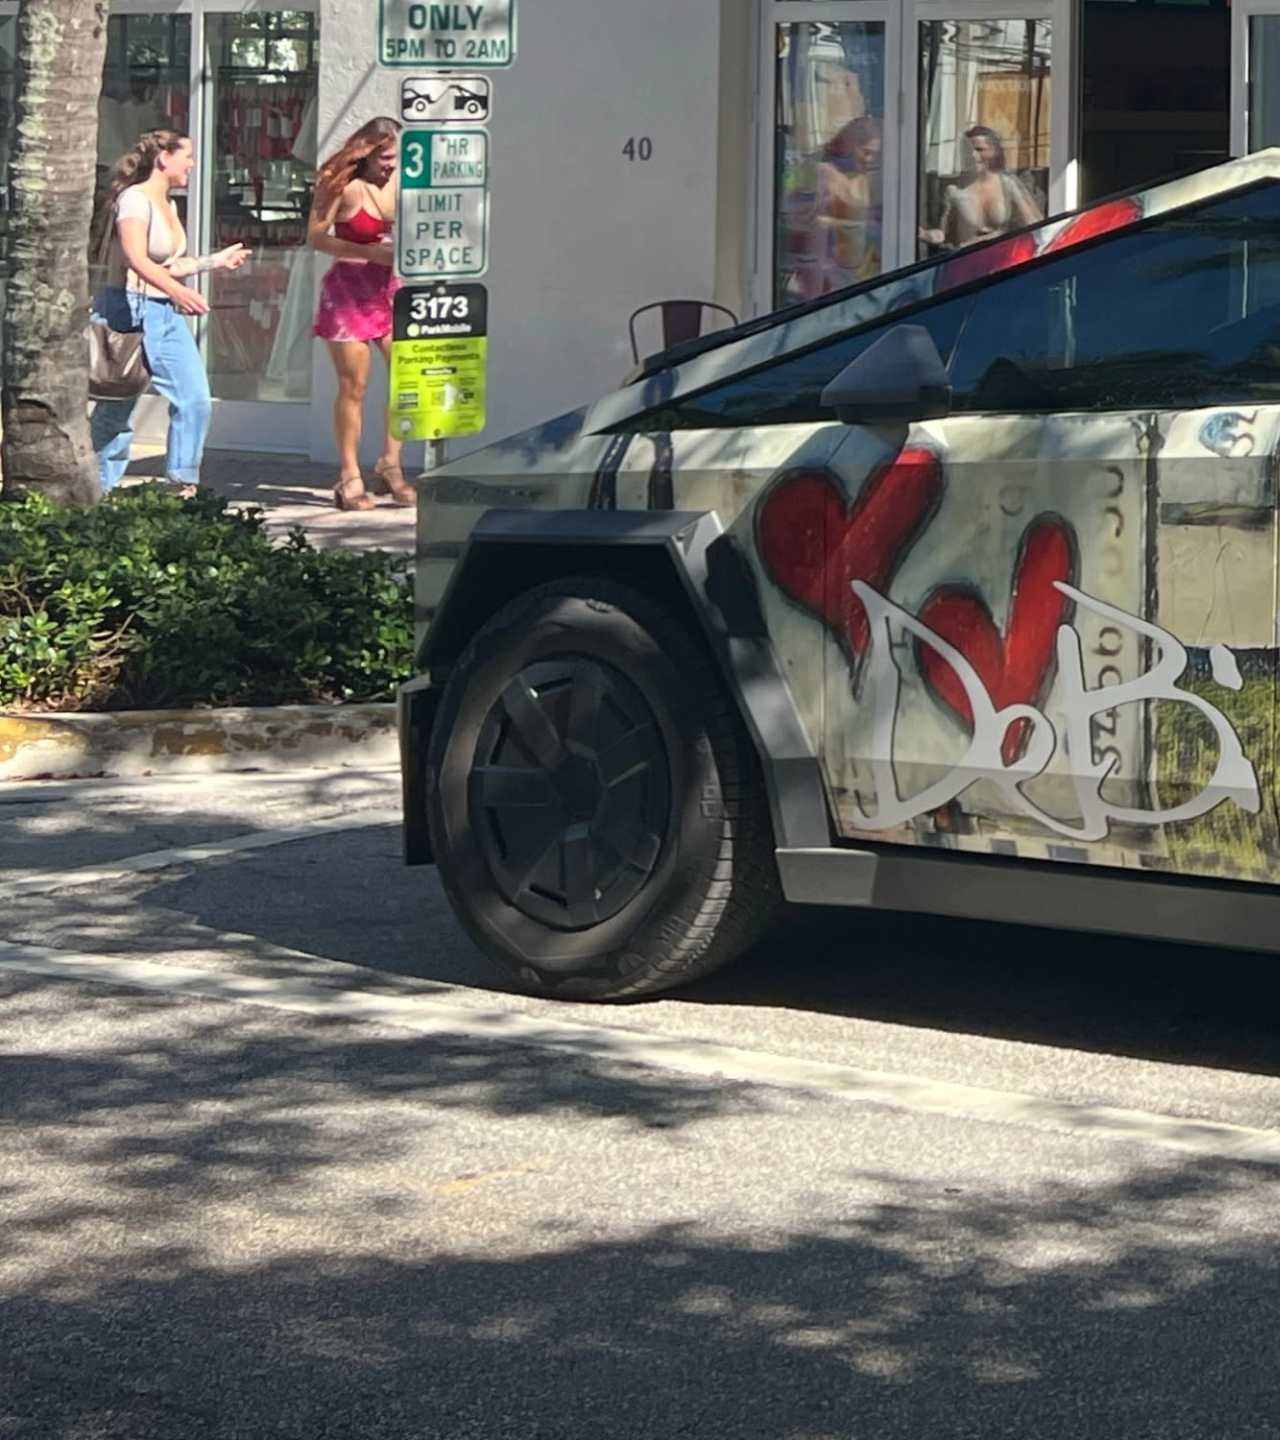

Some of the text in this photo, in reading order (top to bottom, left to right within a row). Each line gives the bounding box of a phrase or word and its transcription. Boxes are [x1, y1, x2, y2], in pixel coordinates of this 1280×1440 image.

[408, 4, 484, 31] ONLY
[385, 38, 507, 58] 5PM TO 2AM
[404, 138, 469, 178] 3 HR
[622, 137, 652, 161] 40
[433, 161, 483, 179] PARKING
[417, 194, 463, 214] LIMIT
[416, 221, 463, 240] PER
[405, 247, 473, 267] SPACE
[410, 295, 469, 320] 3173
